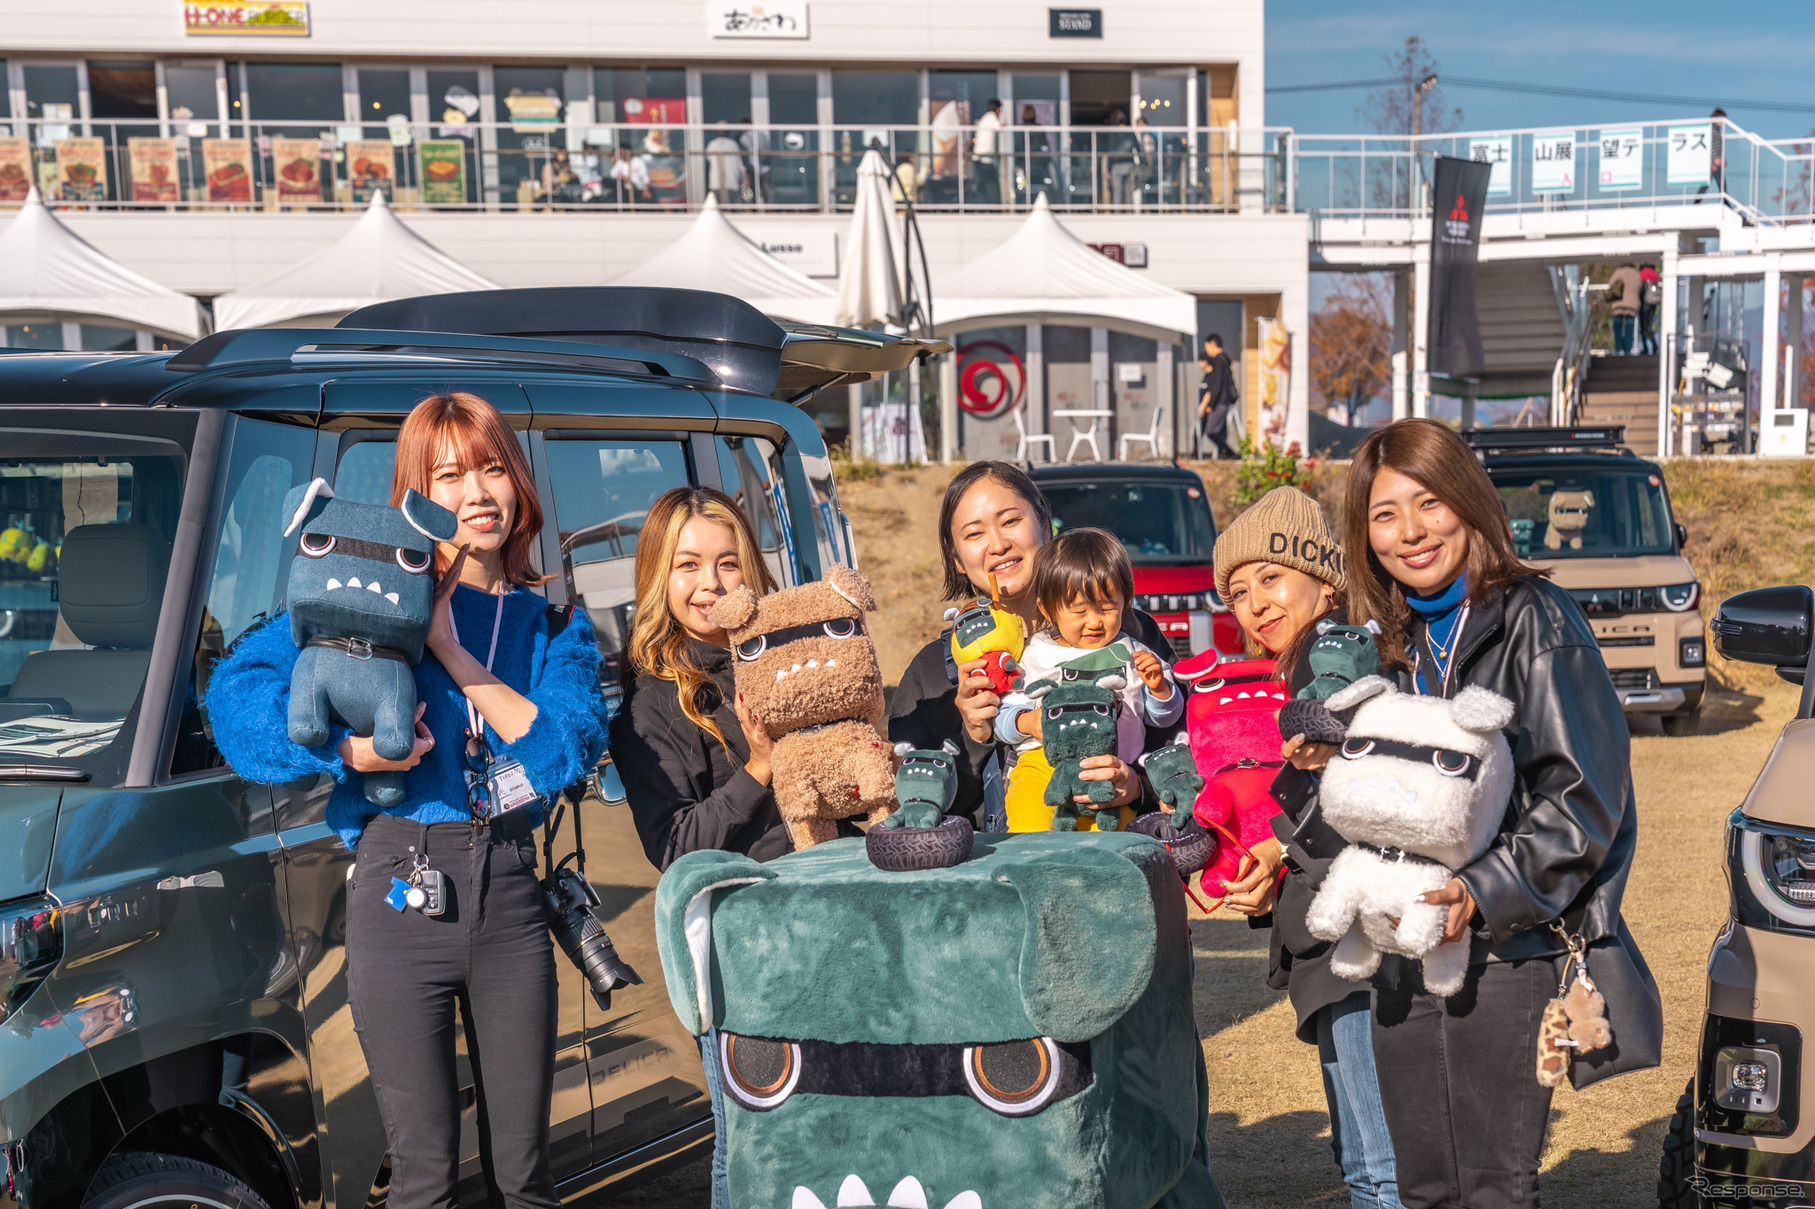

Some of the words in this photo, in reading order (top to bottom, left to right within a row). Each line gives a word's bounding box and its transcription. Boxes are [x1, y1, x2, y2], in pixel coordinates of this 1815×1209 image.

[1058, 19, 1092, 31] STAND
[1471, 142, 1509, 163] 富士
[1534, 141, 1572, 161] 山展
[1602, 138, 1639, 159] 望テ
[1672, 132, 1707, 152] ラス
[1269, 532, 1347, 577] DICKI
[1597, 624, 1650, 634] ICA
[591, 1046, 669, 1086] DELICA
